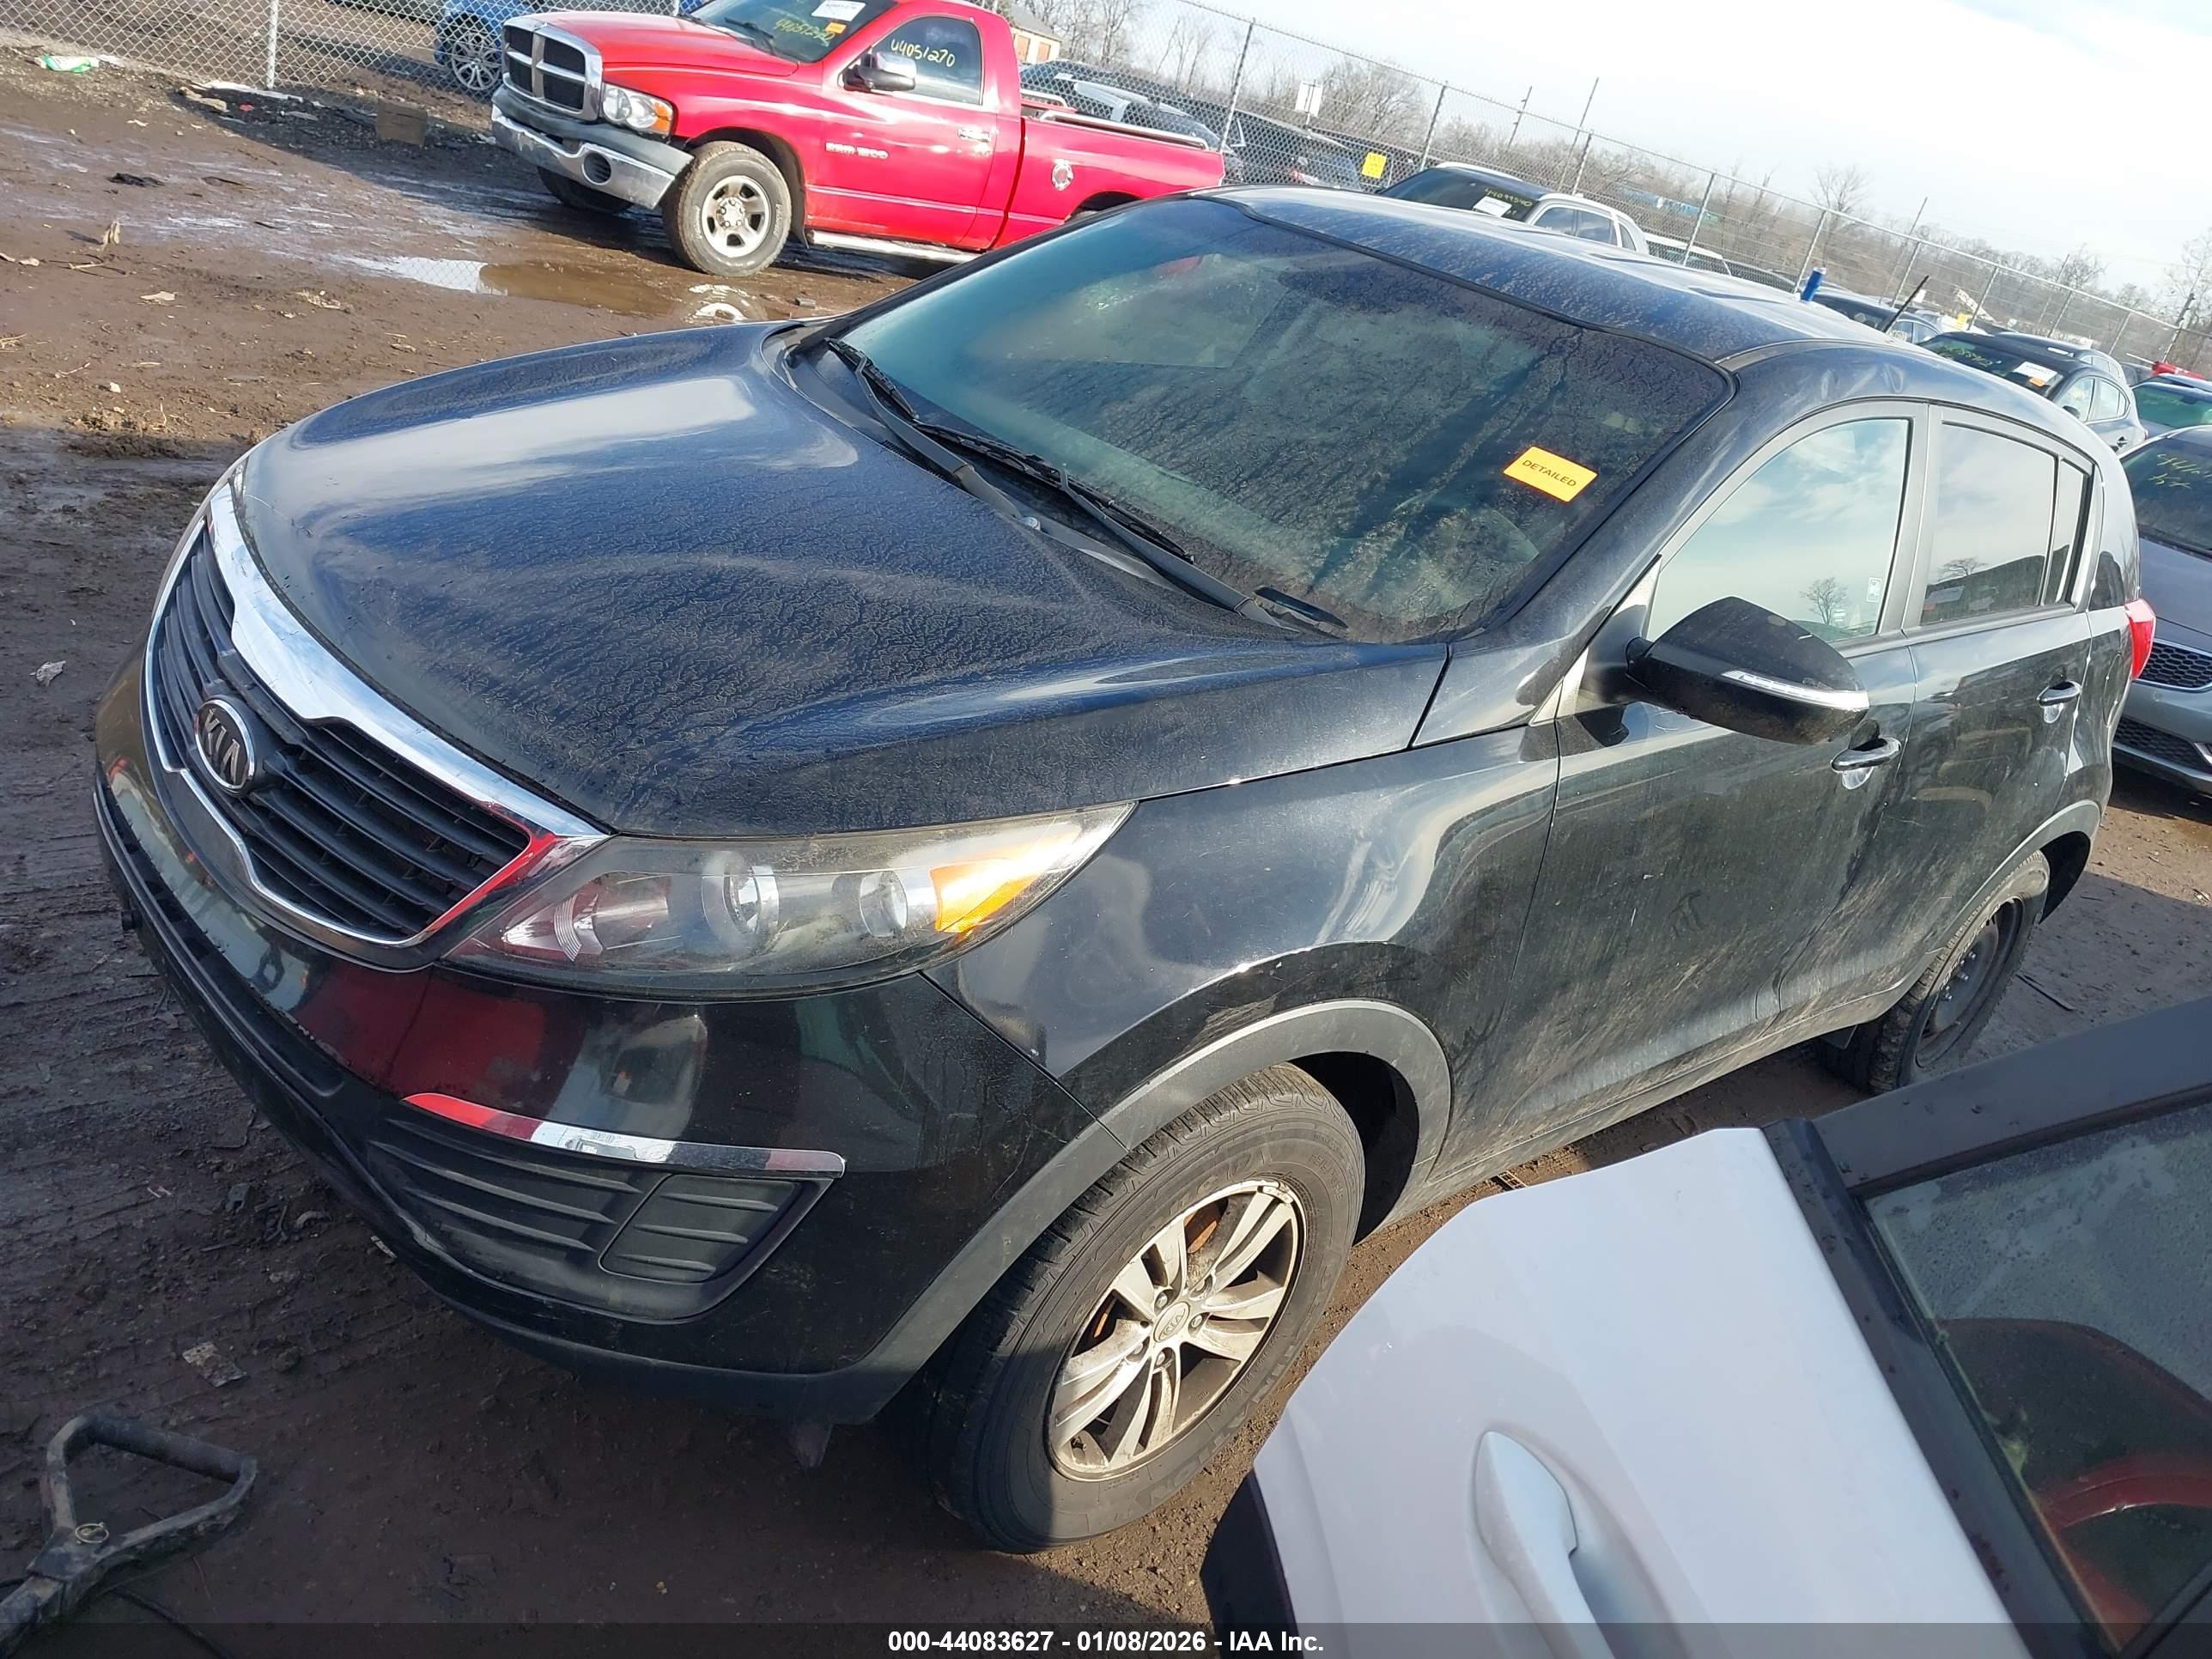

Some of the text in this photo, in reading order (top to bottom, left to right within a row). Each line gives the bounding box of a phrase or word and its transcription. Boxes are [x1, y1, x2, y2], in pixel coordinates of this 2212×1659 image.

[890, 39, 956, 67] 44051270
[1522, 459, 1577, 487] DETAILED
[203, 708, 240, 785] KIA
